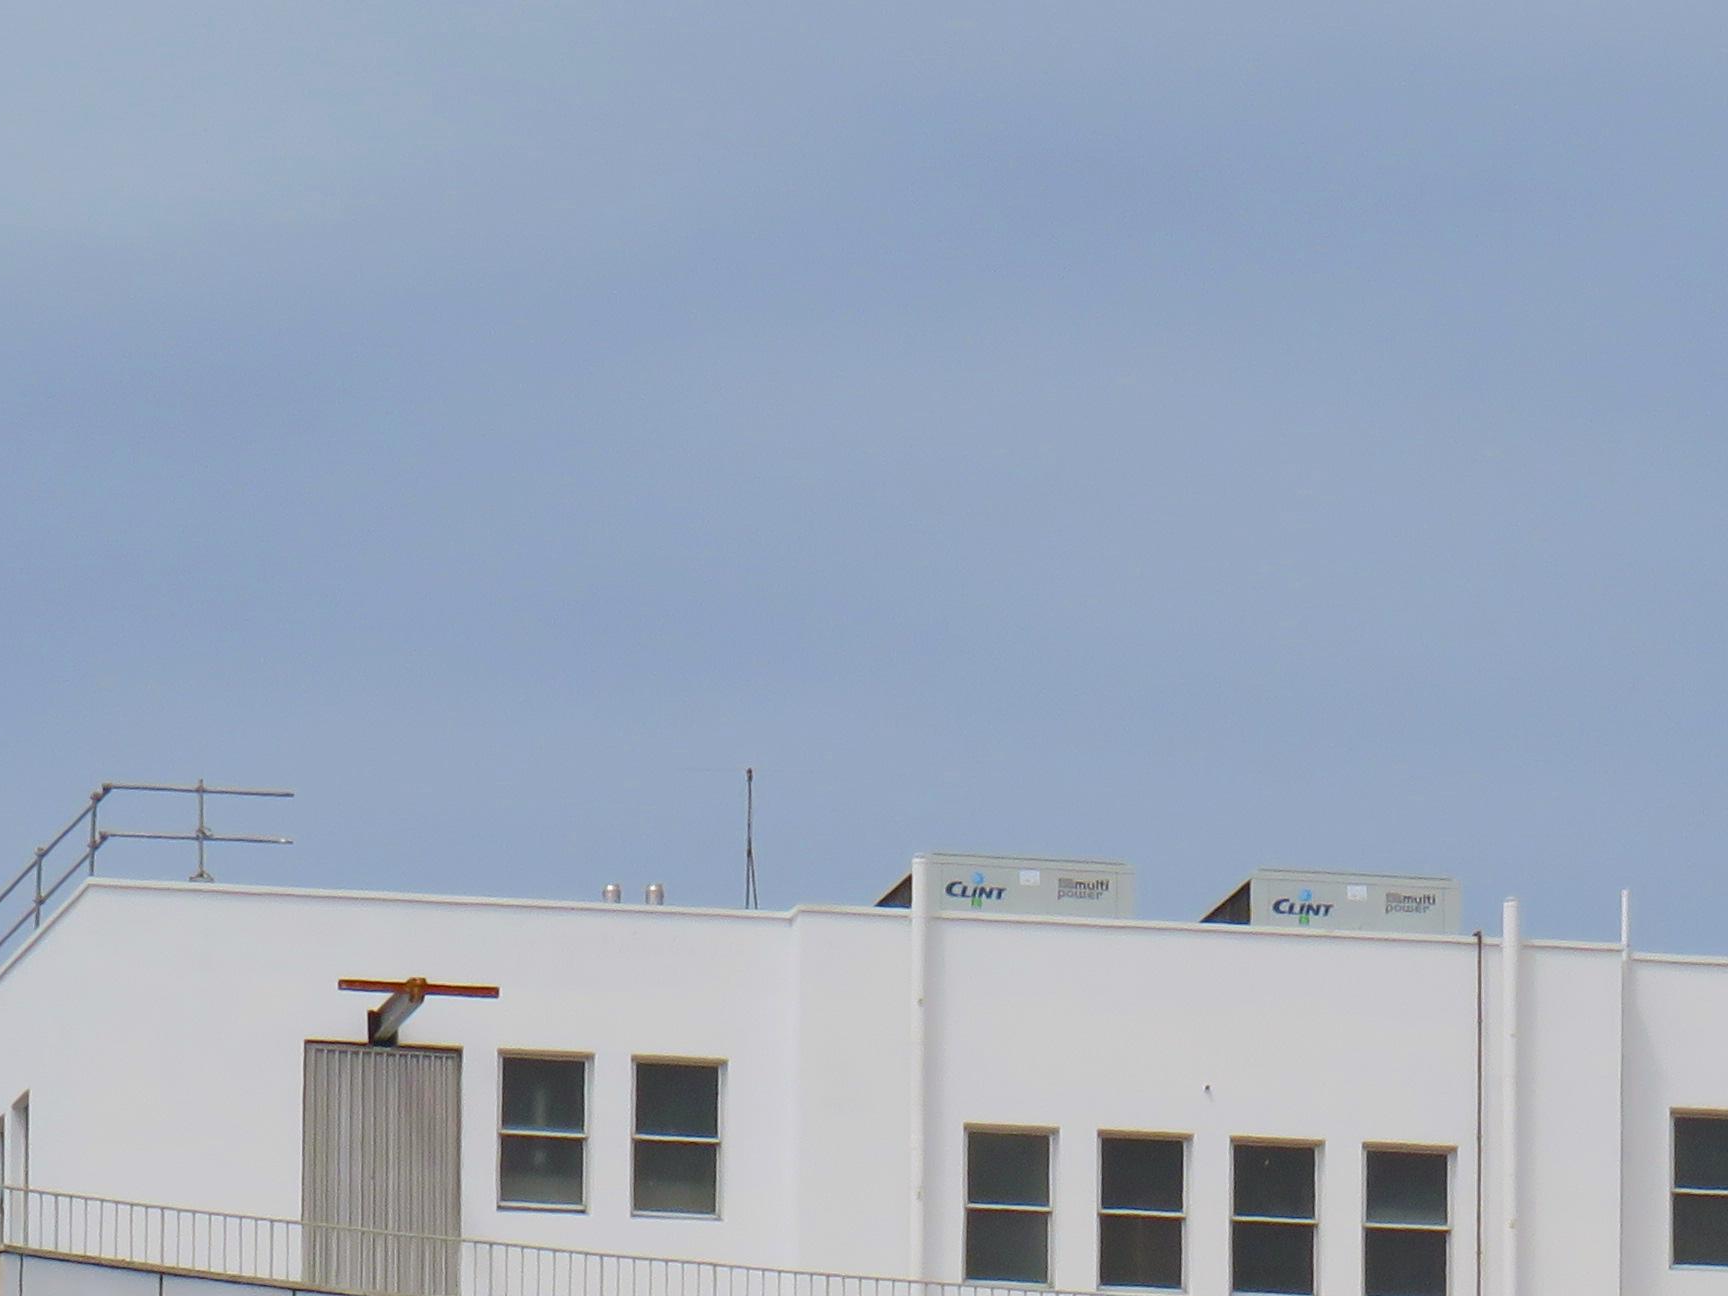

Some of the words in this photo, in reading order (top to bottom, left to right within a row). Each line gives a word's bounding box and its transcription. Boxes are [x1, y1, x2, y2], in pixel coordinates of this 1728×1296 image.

[945, 880, 1007, 900] CLINT
[1075, 879, 1110, 891] multi
[1057, 889, 1103, 900] power
[1403, 893, 1436, 905] multi
[1273, 898, 1334, 917] CLINT
[1385, 903, 1430, 914] power
